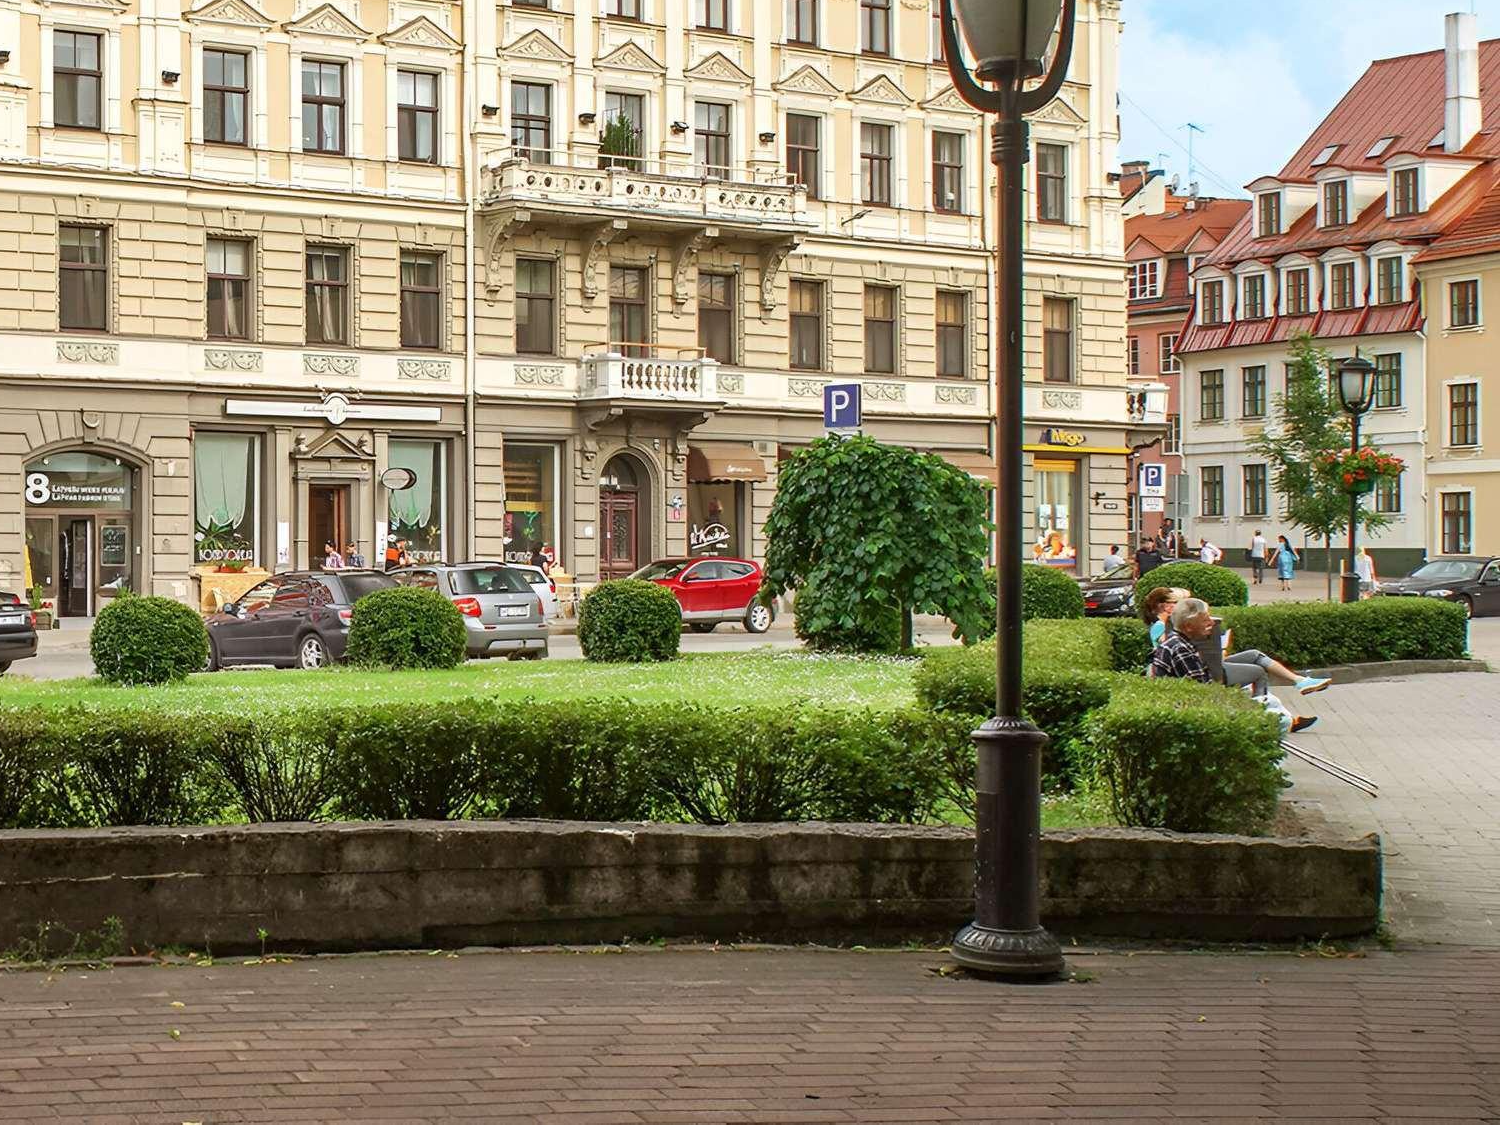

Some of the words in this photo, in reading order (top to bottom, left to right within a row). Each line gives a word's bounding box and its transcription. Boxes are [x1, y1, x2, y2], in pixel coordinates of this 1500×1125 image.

[831, 390, 850, 423] P
[26, 473, 51, 504] 8
[1147, 467, 1159, 485] P
